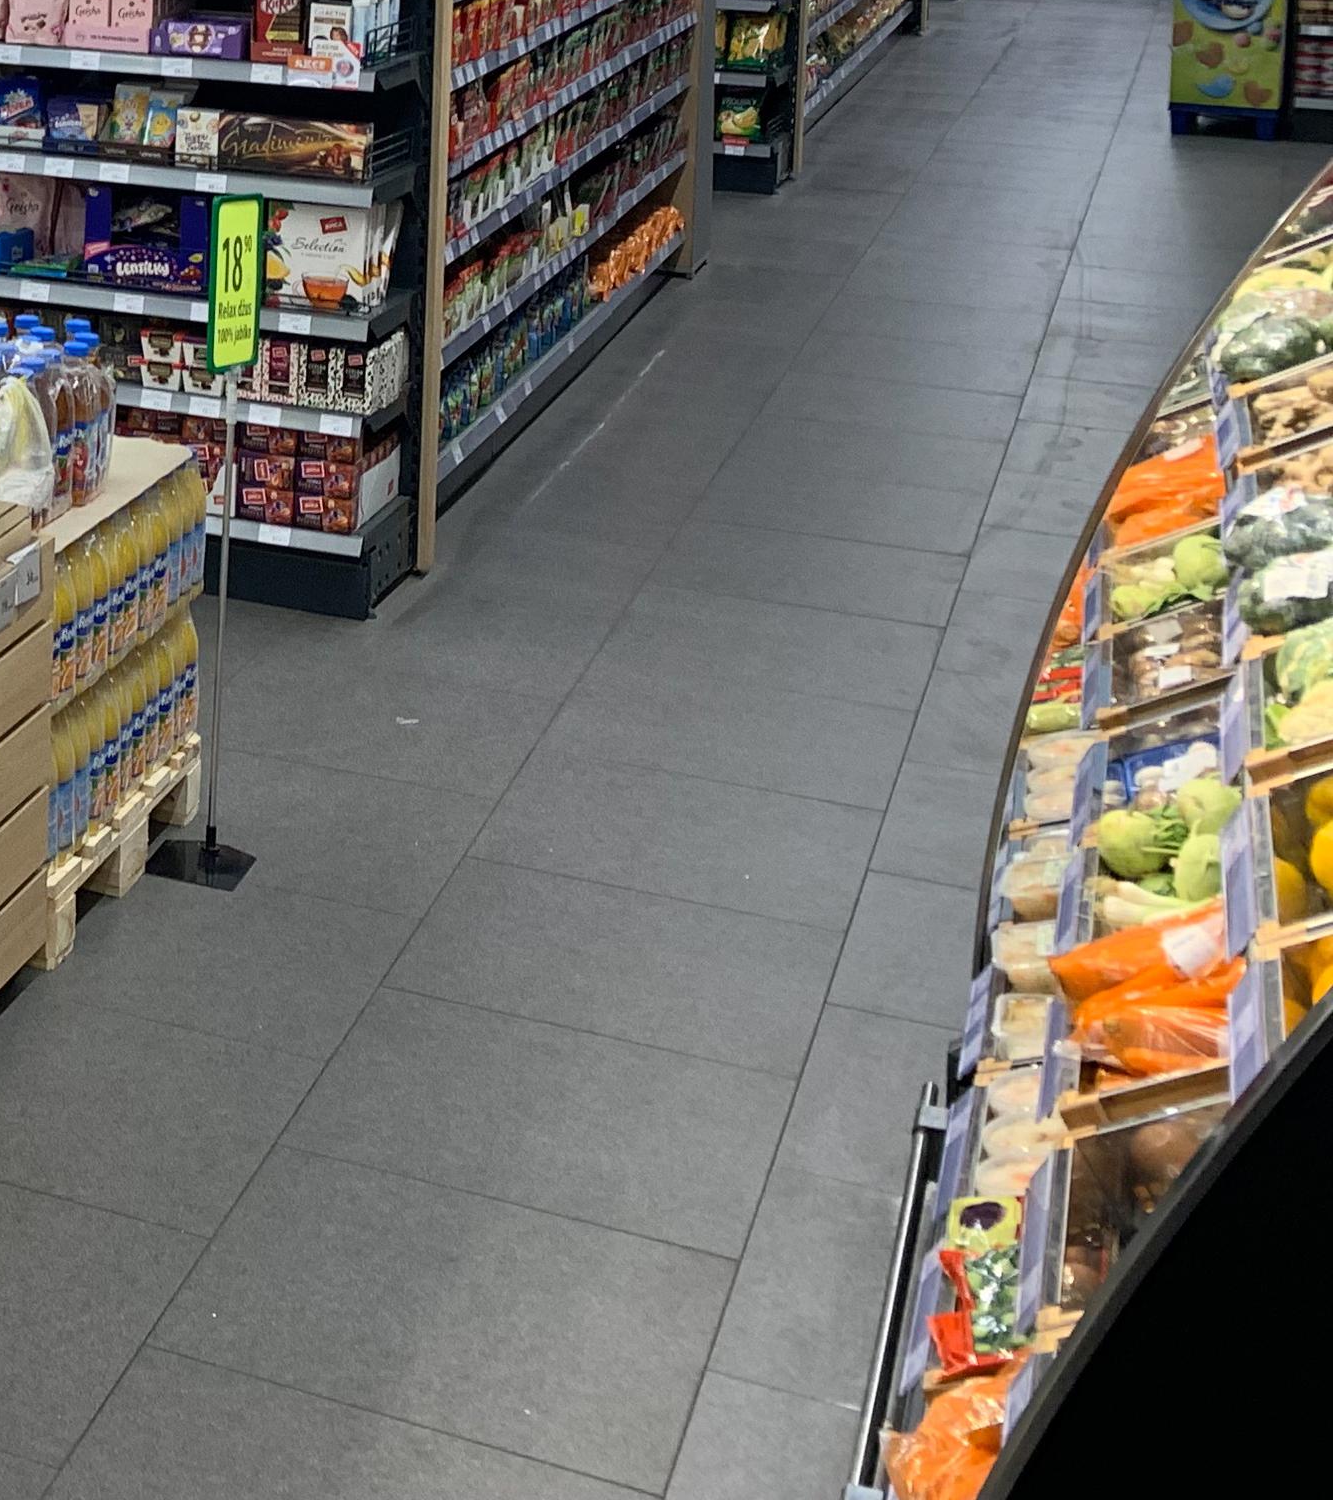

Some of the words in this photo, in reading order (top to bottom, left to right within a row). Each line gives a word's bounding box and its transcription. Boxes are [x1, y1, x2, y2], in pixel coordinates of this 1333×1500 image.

[75, 4, 102, 17] Geisha
[118, 7, 147, 20] Geisha
[222, 236, 243, 293] 18
[218, 302, 237, 320] Relax
